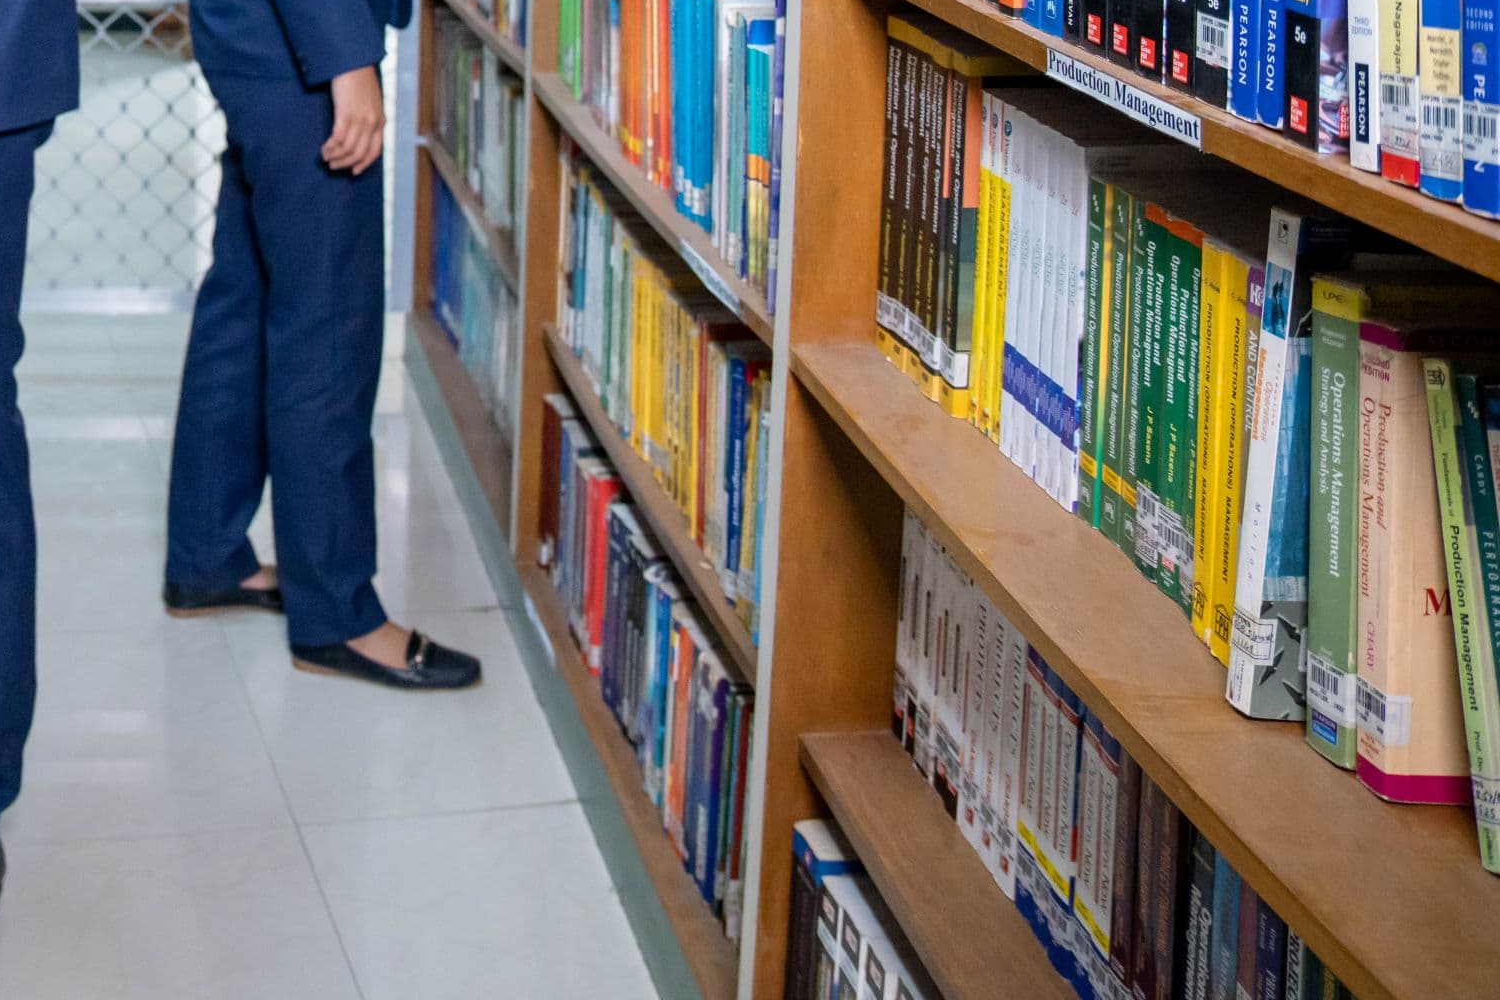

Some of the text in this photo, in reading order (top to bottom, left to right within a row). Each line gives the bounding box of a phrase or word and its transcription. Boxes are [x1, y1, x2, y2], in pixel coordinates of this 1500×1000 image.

[1239, 4, 1248, 85] PEARSON
[1050, 53, 1199, 140] Production Management
[1356, 70, 1366, 138] PEARSON
[1166, 256, 1180, 404] Operations Management
[1178, 288, 1189, 384] Production and
[1250, 329, 1258, 360] AND
[1320, 367, 1330, 415] Strategy
[1363, 367, 1391, 383] EDITION
[1222, 318, 1240, 584] PRODUCTION (OPERATIONS) MANAGEMENT
[1318, 441, 1330, 494] Analysis
[1329, 371, 1345, 578] Operations Management
[1376, 402, 1392, 530] Production and
[1475, 454, 1487, 498] CARDY
[1360, 396, 1376, 598] Operations Management
[1367, 621, 1375, 670] CHARY
[1451, 524, 1479, 712] Production Management
